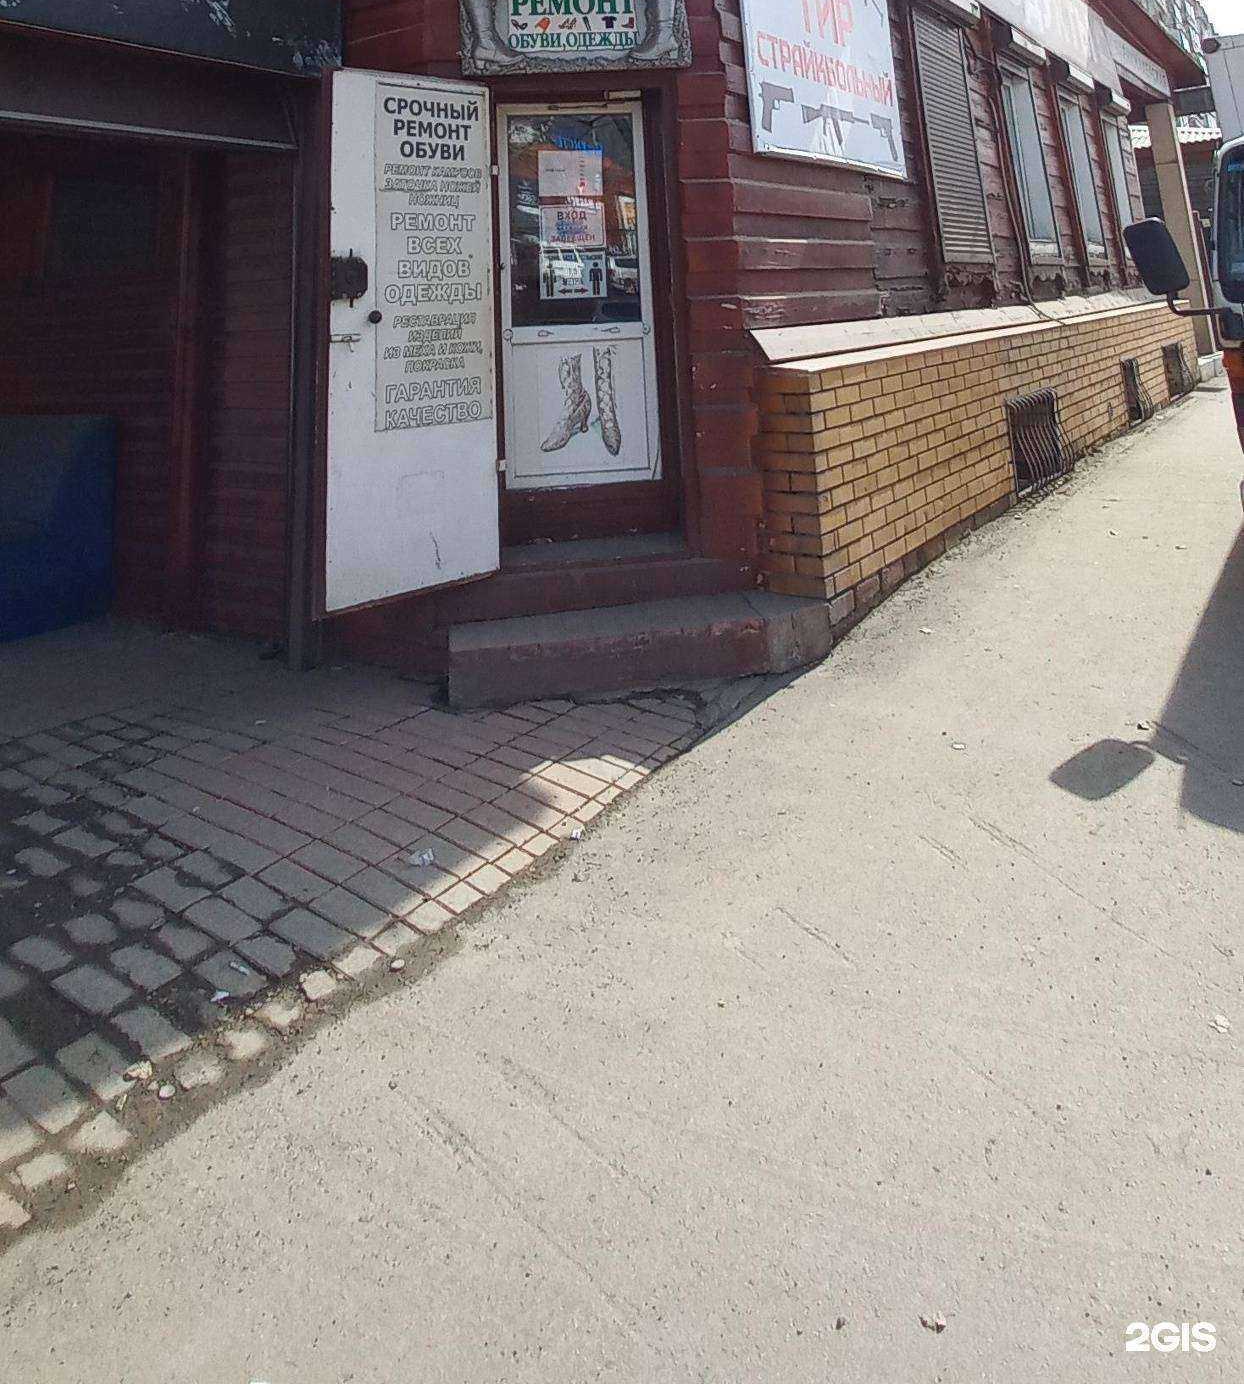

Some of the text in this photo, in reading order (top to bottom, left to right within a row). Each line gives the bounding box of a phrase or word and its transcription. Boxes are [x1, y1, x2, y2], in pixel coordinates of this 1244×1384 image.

[757, 31, 893, 107] СТРАЙКБОЛЬНЫЙ
[383, 97, 479, 121] СРОЧНЫЙ
[393, 119, 472, 141] РЕМОНТ
[400, 140, 465, 161] ОБУВИ
[384, 163, 431, 176] РЕМОНТ
[384, 178, 438, 192] ЗАТОЧКА
[408, 193, 460, 208] НОЖНИЦ
[390, 212, 476, 232] РЕМОНТ
[557, 211, 588, 221] ВХОД
[407, 236, 462, 254] ВСЕХ
[398, 259, 471, 281] ВИДОВ
[385, 283, 482, 306] ОДЕЖДЫ
[393, 312, 477, 328] РЕСТАВРАЦИЯ
[384, 346, 401, 359] ИЗ
[403, 344, 436, 357] МЕХА
[438, 343, 448, 355] И
[405, 356, 465, 373] ПОКРАСКА
[385, 376, 481, 404] ГАРАНТИЯ
[385, 400, 481, 430] КАЧЕСТВО
